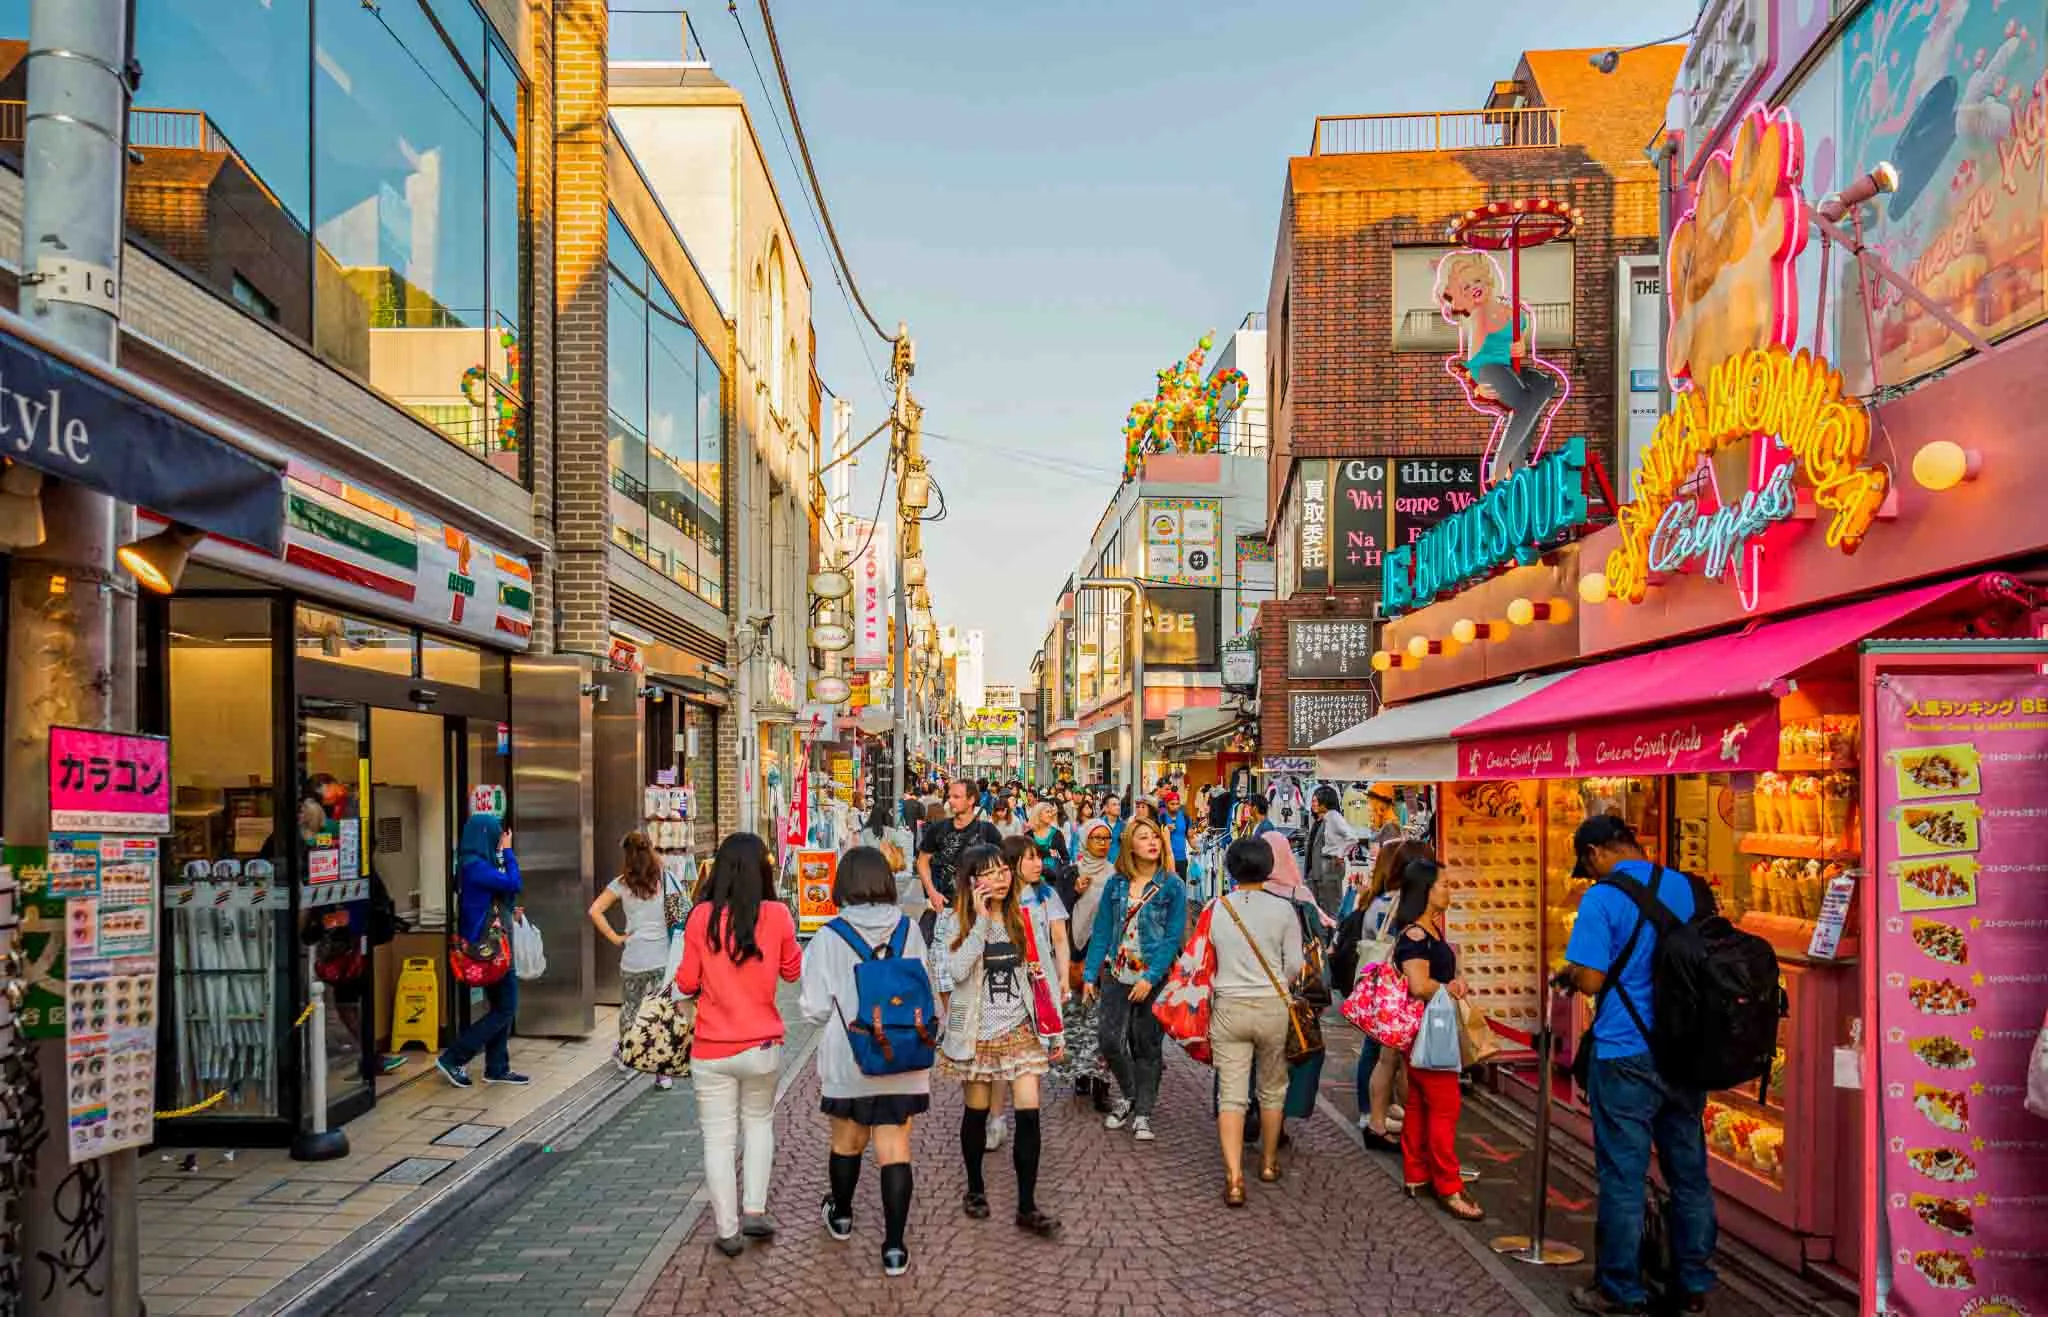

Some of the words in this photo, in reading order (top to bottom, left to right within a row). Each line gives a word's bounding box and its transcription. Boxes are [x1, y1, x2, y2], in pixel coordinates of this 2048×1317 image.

[1634, 280, 1661, 295] THE
[1708, 348, 1880, 550] MONICA
[1414, 438, 1586, 608] BURLESQUE
[1648, 460, 1798, 578] Crepes
[59, 753, 163, 796] カラコン
